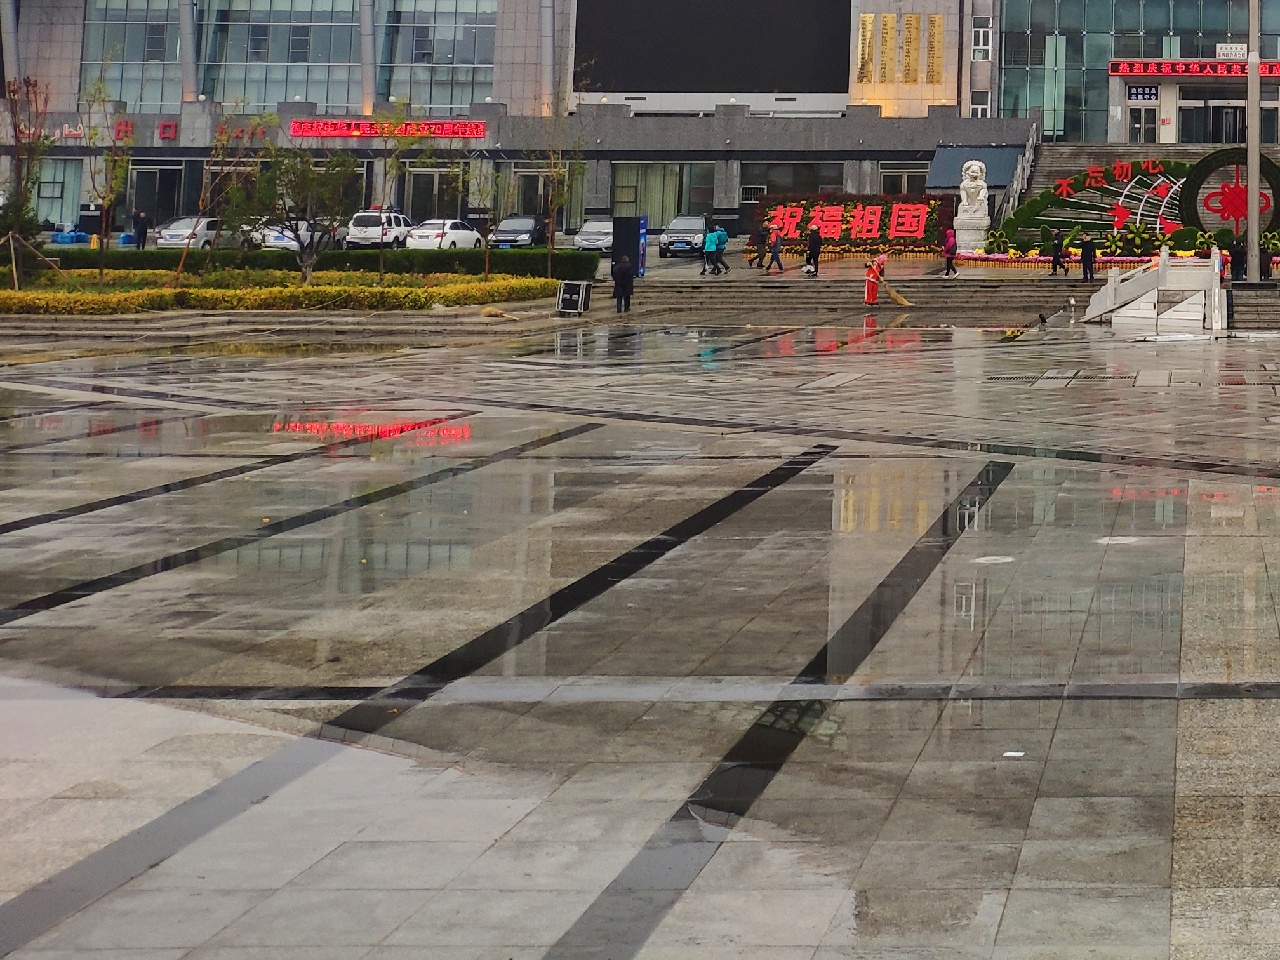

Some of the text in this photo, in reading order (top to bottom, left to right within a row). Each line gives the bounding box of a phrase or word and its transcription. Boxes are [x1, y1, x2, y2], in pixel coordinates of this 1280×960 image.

[114, 119, 177, 139] 出口
[1055, 157, 1164, 198] 不忘初心
[768, 203, 928, 239] 祝福祖国
